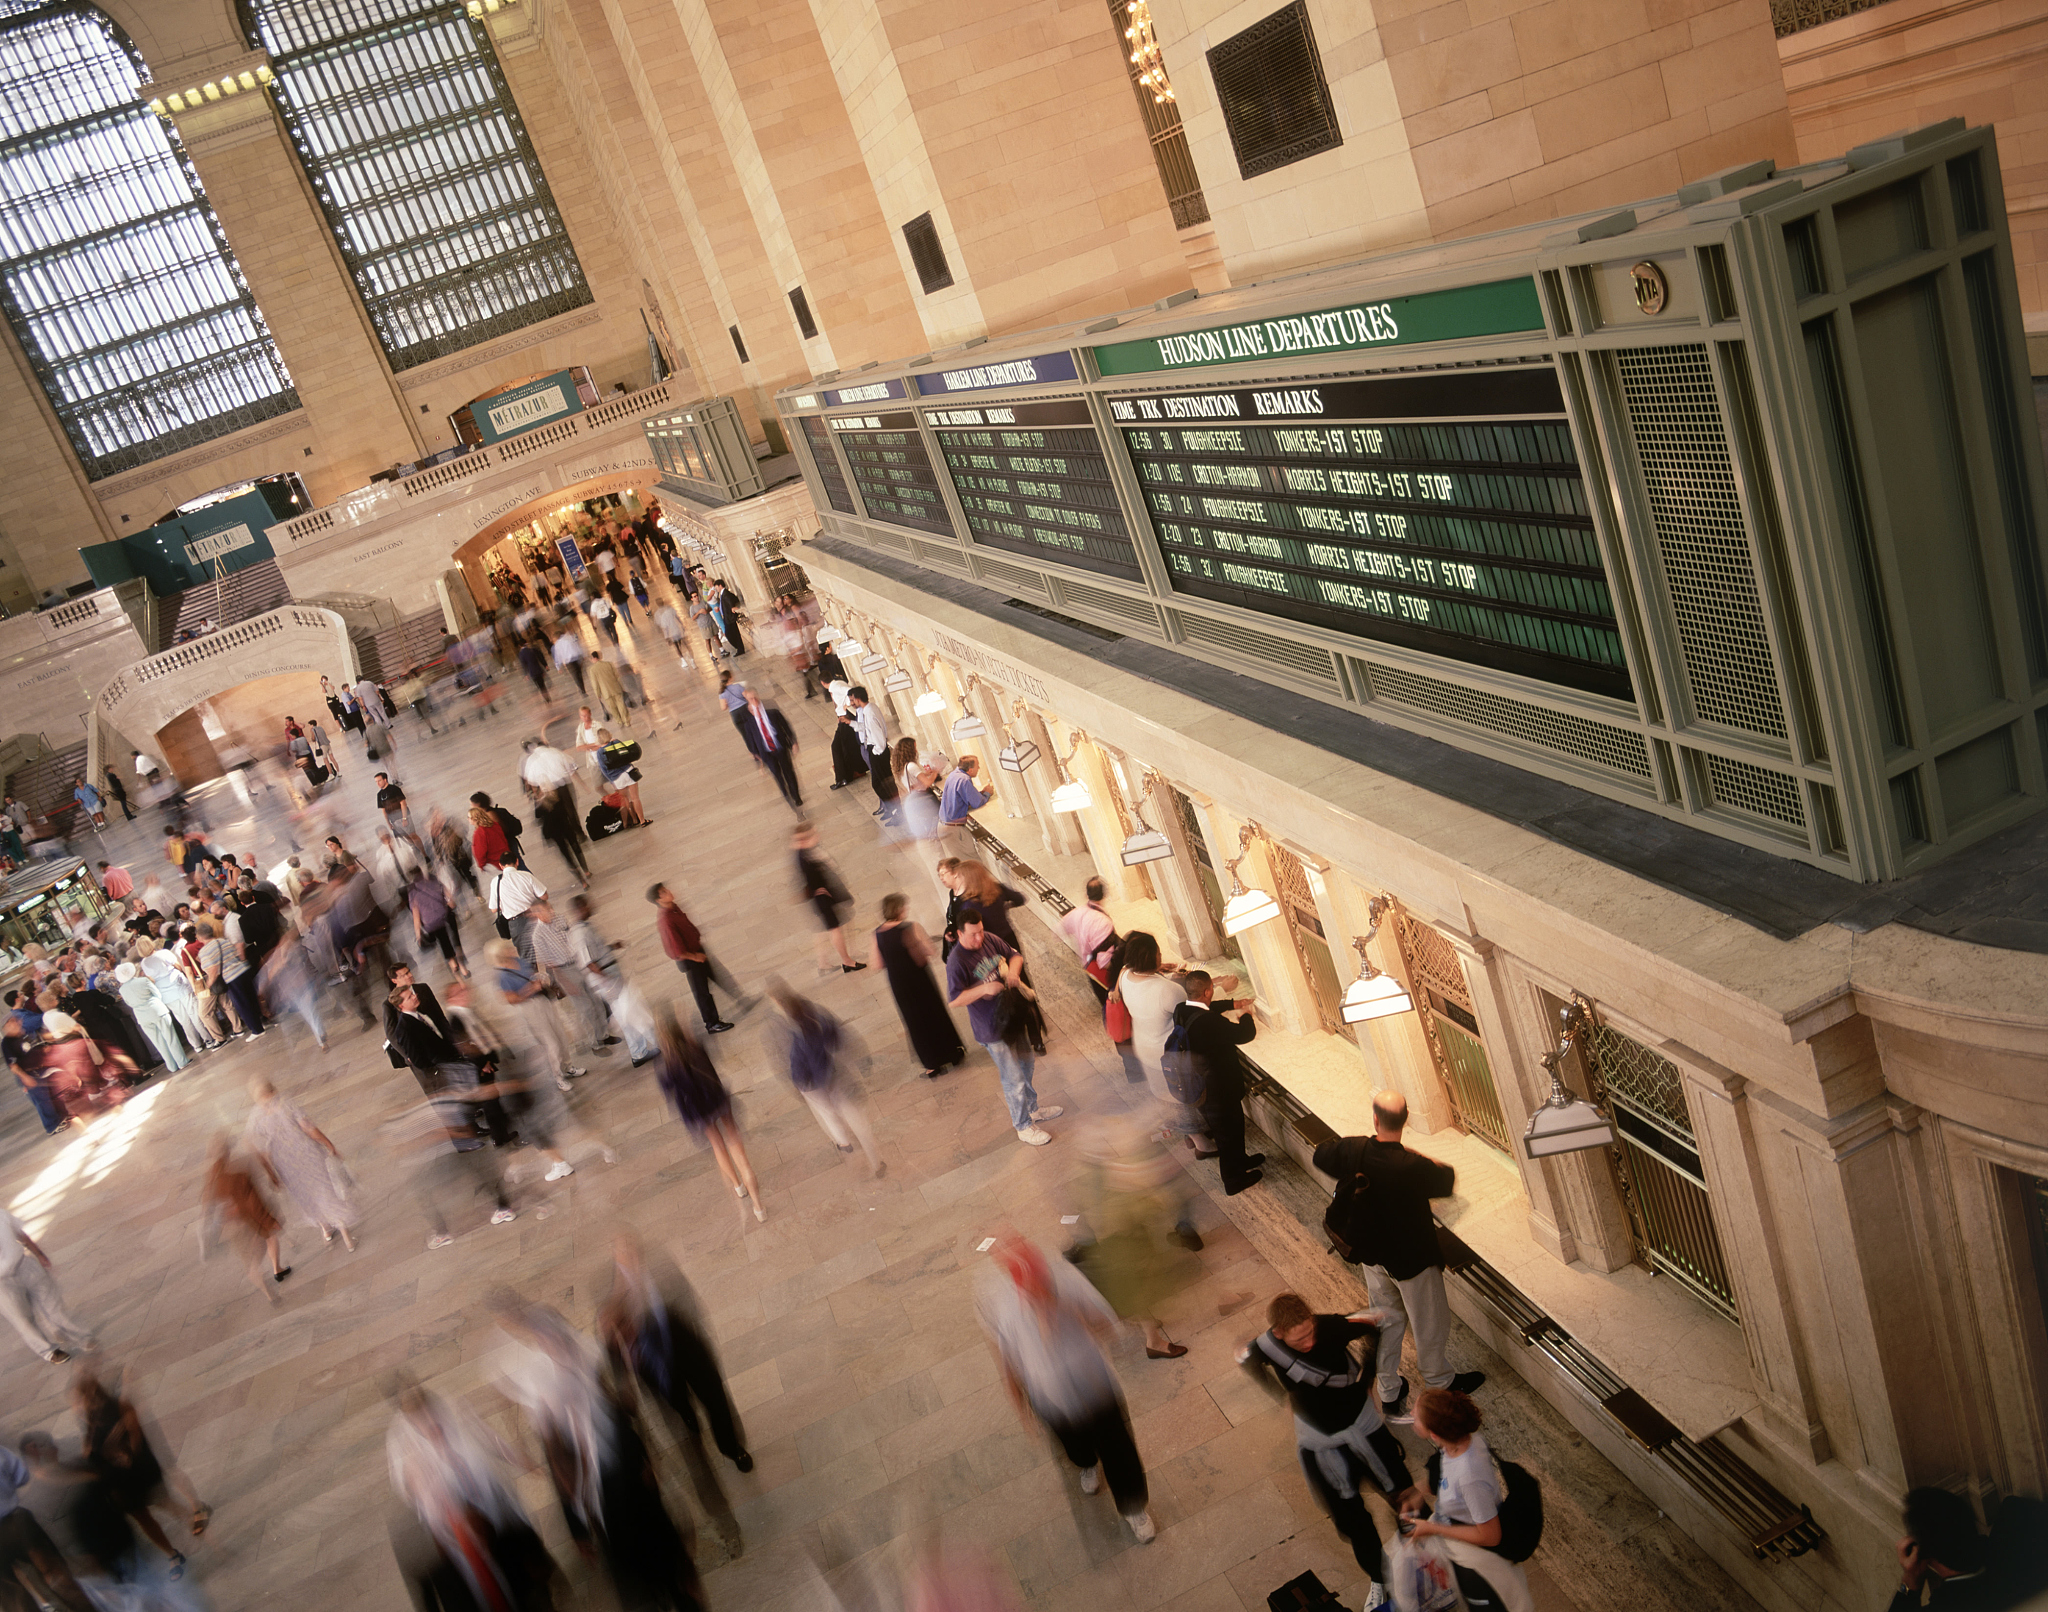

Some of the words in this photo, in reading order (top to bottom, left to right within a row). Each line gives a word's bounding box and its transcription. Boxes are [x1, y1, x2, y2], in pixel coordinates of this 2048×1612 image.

[1157, 331, 1226, 365] HUDSON
[1222, 324, 1267, 358] LINE
[1265, 303, 1399, 353] DEPARTURES
[969, 367, 989, 387] LINE
[986, 359, 1037, 385] DEPARTURES
[493, 395, 548, 427] MÉTRAZUR
[985, 408, 1015, 424] REMARKS
[1110, 401, 1136, 420] TIME
[1137, 399, 1162, 419] TRK
[1162, 394, 1240, 418] DESTINATION
[1252, 389, 1323, 415] REMARKS
[1129, 432, 1152, 449] 12:56
[1160, 432, 1173, 450] 30
[1181, 431, 1245, 451] POUGHKEEPSIE
[1274, 430, 1348, 453] YONKERS-1ST
[1351, 430, 1383, 453] STOP
[572, 463, 609, 480] SUBWAY
[622, 459, 646, 468] 42ND
[1142, 463, 1162, 480] 1:20
[1285, 469, 1327, 491] MORRIS
[1329, 470, 1411, 498] HEIGHTS-1ST
[1417, 475, 1452, 500] STOP
[473, 495, 523, 529] LEXINGTON
[525, 486, 542, 499] AVE
[492, 525, 511, 540] 42ND
[511, 510, 537, 529] STREET
[538, 497, 570, 514] PASSAGE
[573, 485, 605, 500] SUBWAY
[1153, 494, 1172, 511] 1:56
[1181, 496, 1193, 514] 24
[1202, 498, 1267, 523] POUGHKEEPSIE
[1296, 506, 1371, 534] YONKERS-1ST
[1375, 513, 1407, 539] STOP
[354, 552, 370, 563] EAST
[372, 539, 404, 556] BALCONY
[1161, 524, 1182, 542] 2:20
[1191, 528, 1203, 546] 23
[1307, 544, 1349, 570] MORRIS
[1352, 550, 1435, 583] HEIGHTS-1ST
[1441, 561, 1476, 590] STOP
[1171, 553, 1191, 573] 2:56
[1223, 563, 1288, 593] POUGHKEEPSIE
[1318, 580, 1393, 614] YONKERS-1ST
[1398, 595, 1430, 621] STOP
[17, 678, 35, 689] EAST
[36, 664, 71, 682] BALCONY
[244, 668, 270, 680] DINING
[272, 663, 311, 673] CONCOURSE
[163, 703, 184, 721] TRACKS
